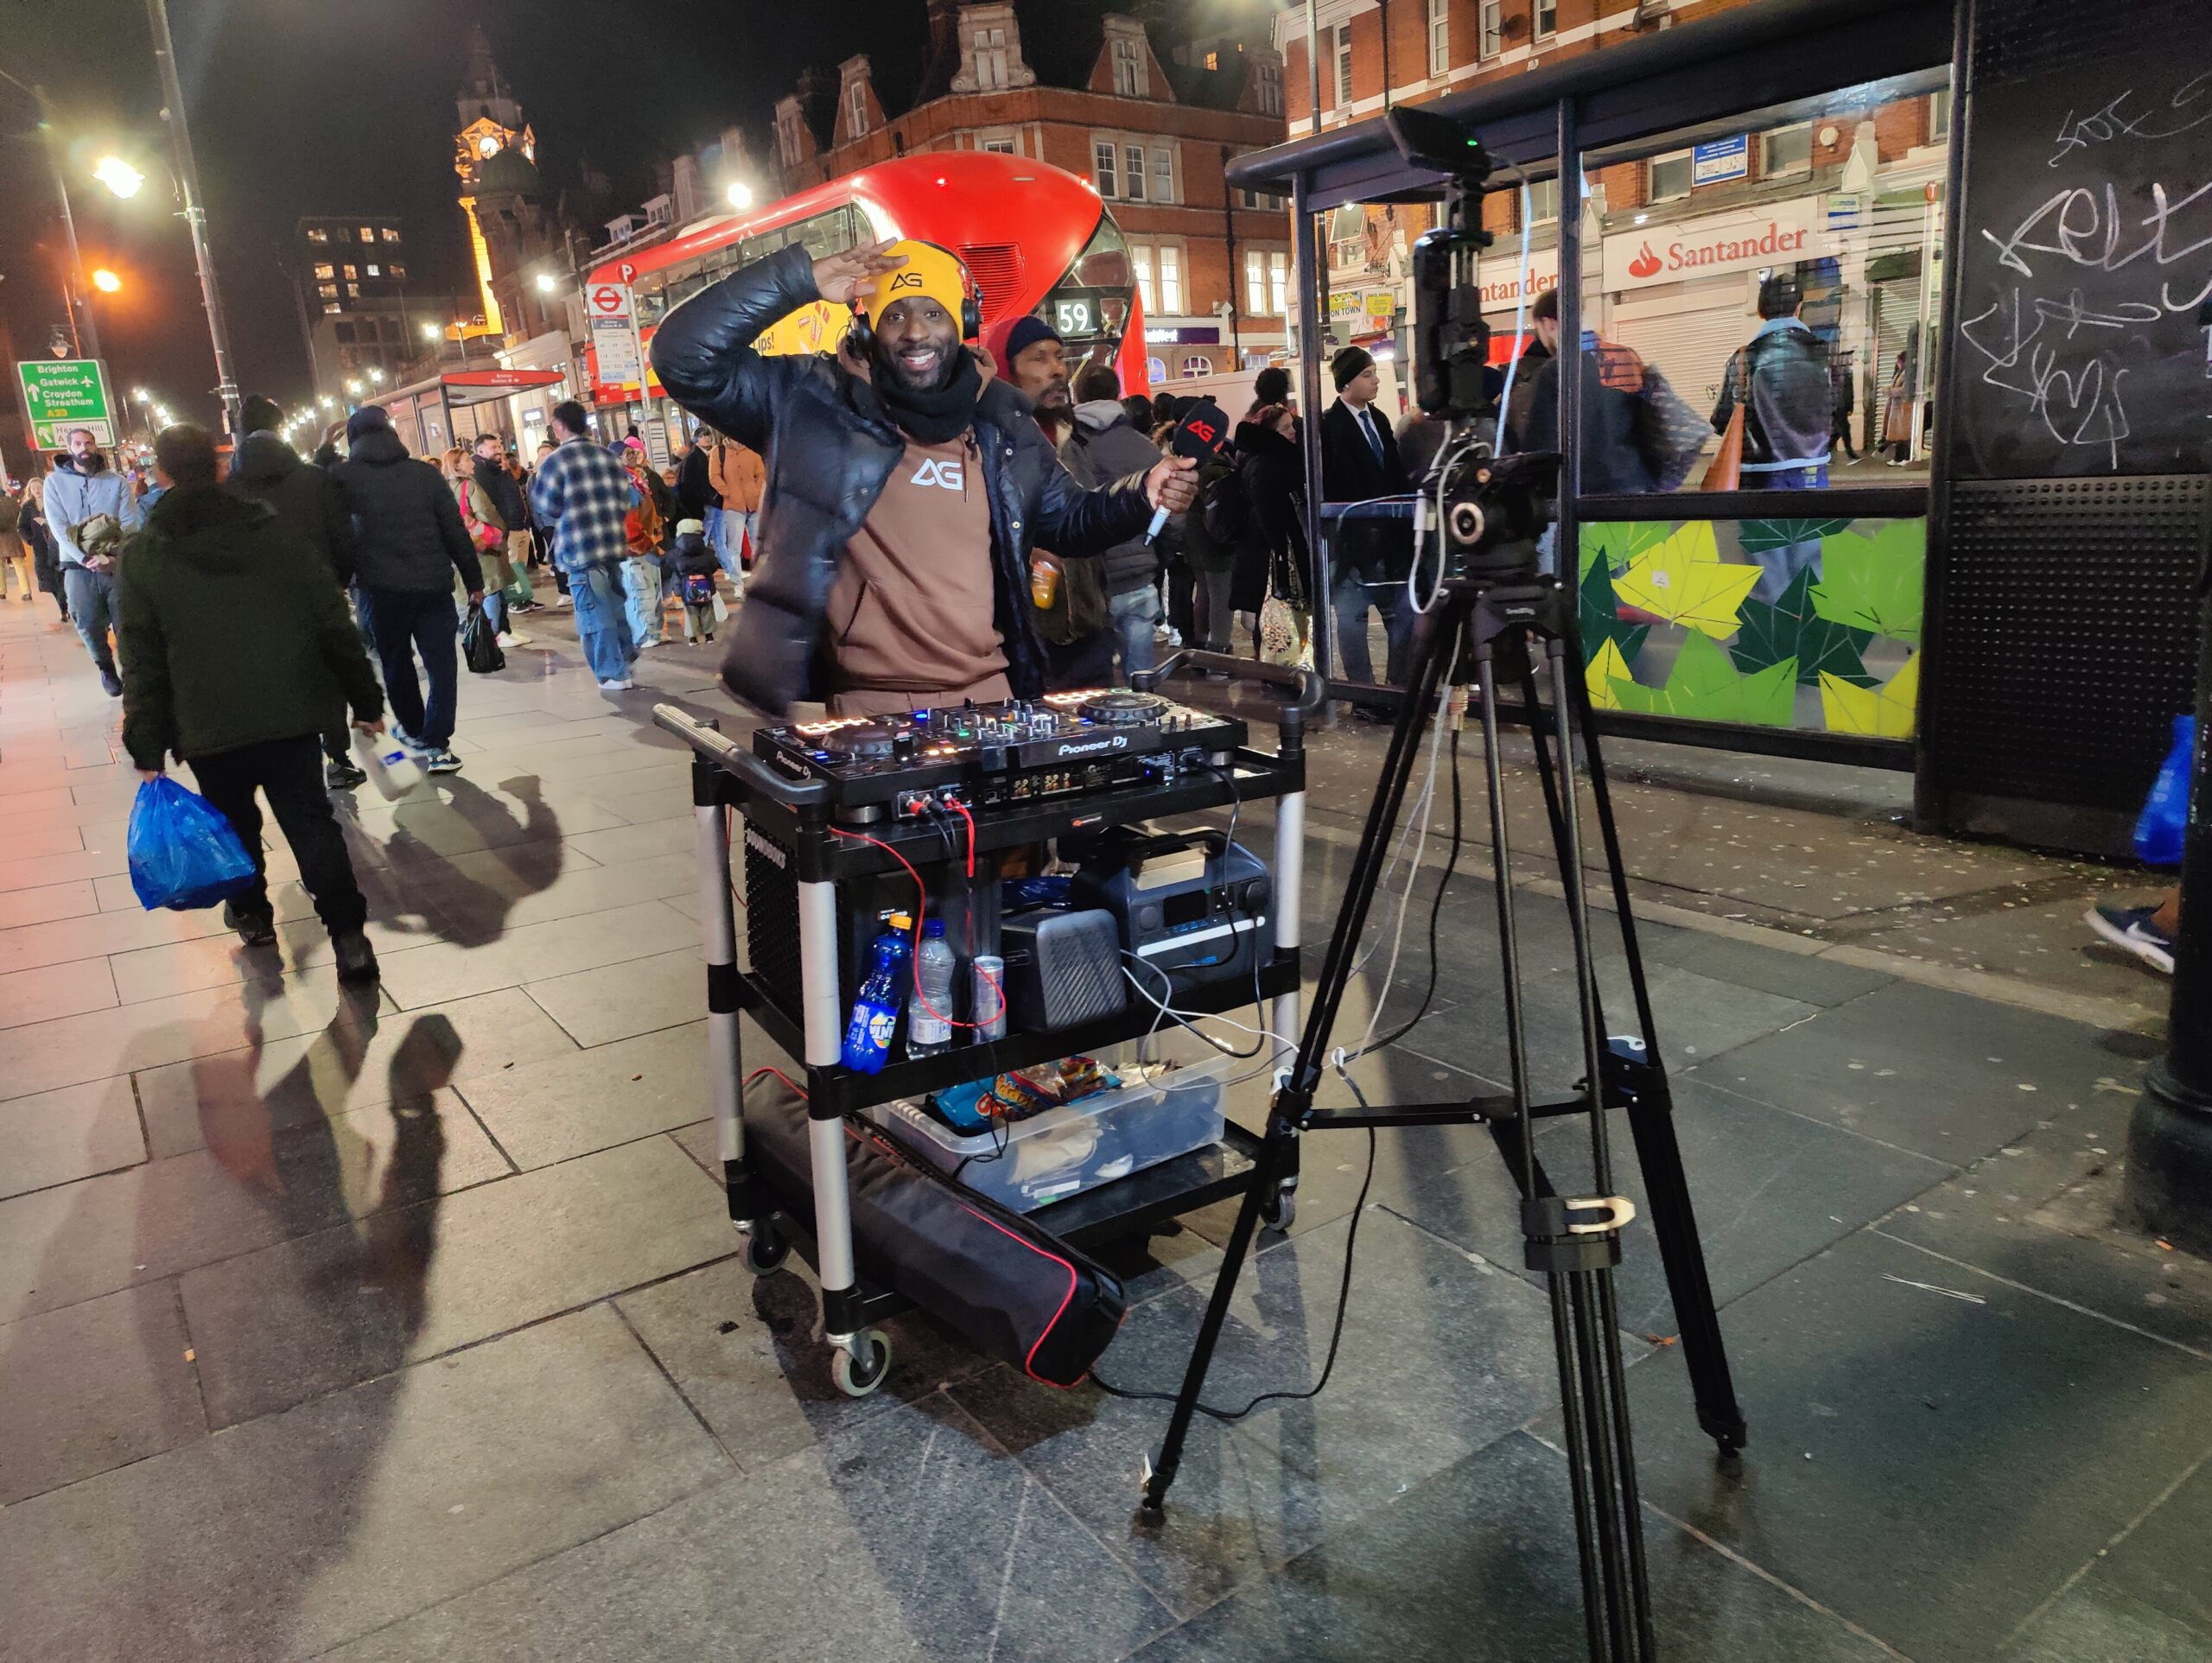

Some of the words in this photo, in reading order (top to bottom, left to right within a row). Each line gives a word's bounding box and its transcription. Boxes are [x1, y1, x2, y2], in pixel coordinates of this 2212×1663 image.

[1668, 221, 1808, 271] Santander
[622, 264, 633, 283] P
[890, 273, 923, 291] AG
[1479, 268, 1558, 303] ntander
[1060, 303, 1089, 333] 59
[1342, 306, 1361, 315] TOWN
[37, 365, 79, 374] Brighton
[40, 378, 79, 386] Gatwick
[42, 390, 83, 399] Croydon
[87, 423, 105, 432] Hill
[1187, 420, 1216, 443] AG
[911, 458, 963, 490] AG
[1058, 740, 1111, 756] Pioneer
[777, 751, 803, 772] Pioneer
